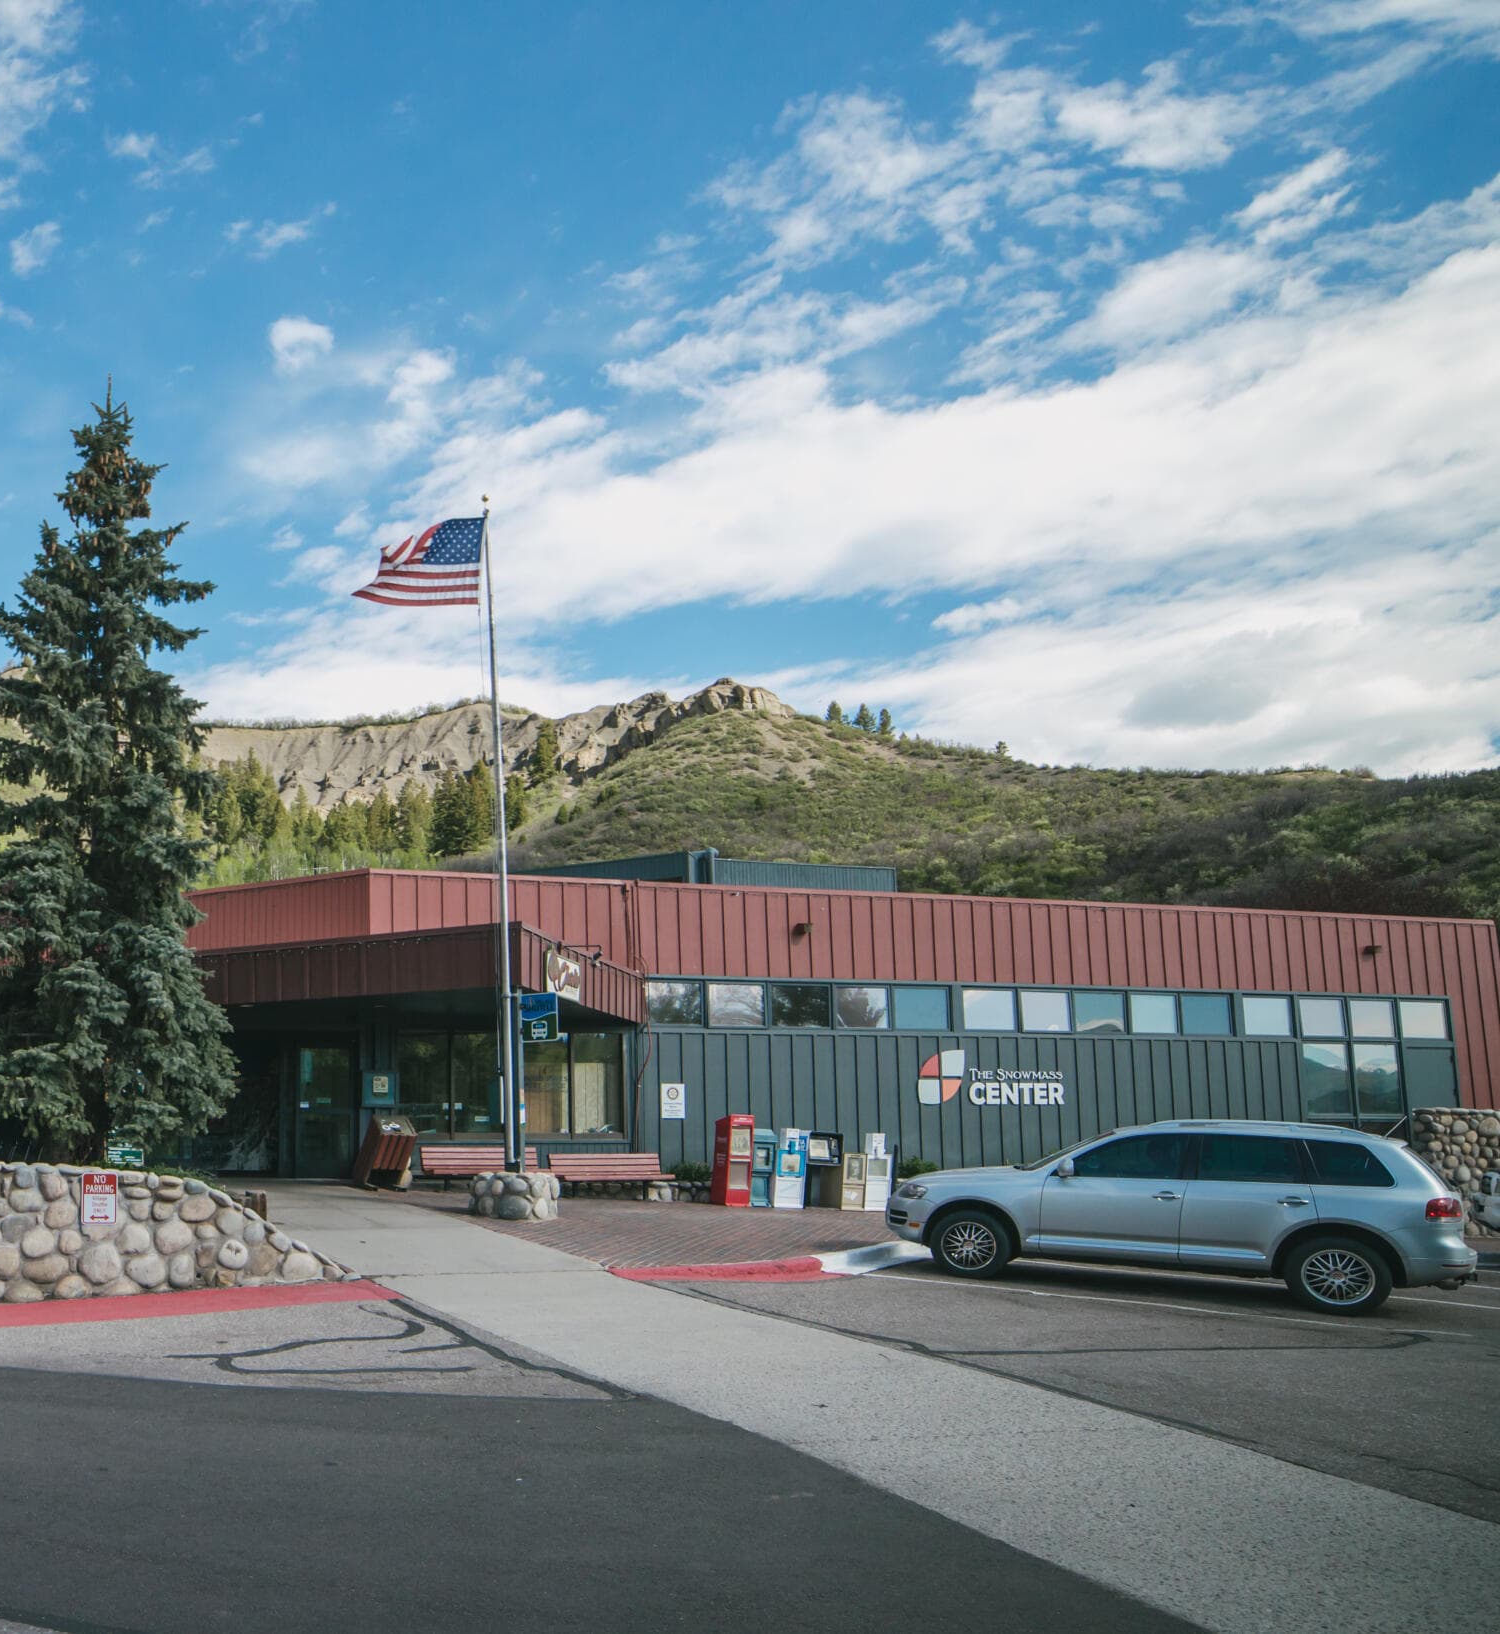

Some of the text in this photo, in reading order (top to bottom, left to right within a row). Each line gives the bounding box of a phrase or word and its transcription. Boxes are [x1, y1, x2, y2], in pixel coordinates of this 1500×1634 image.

[968, 1081, 1065, 1105] CENTER
[93, 1174, 107, 1184] NO
[85, 1184, 115, 1194] PARKING
